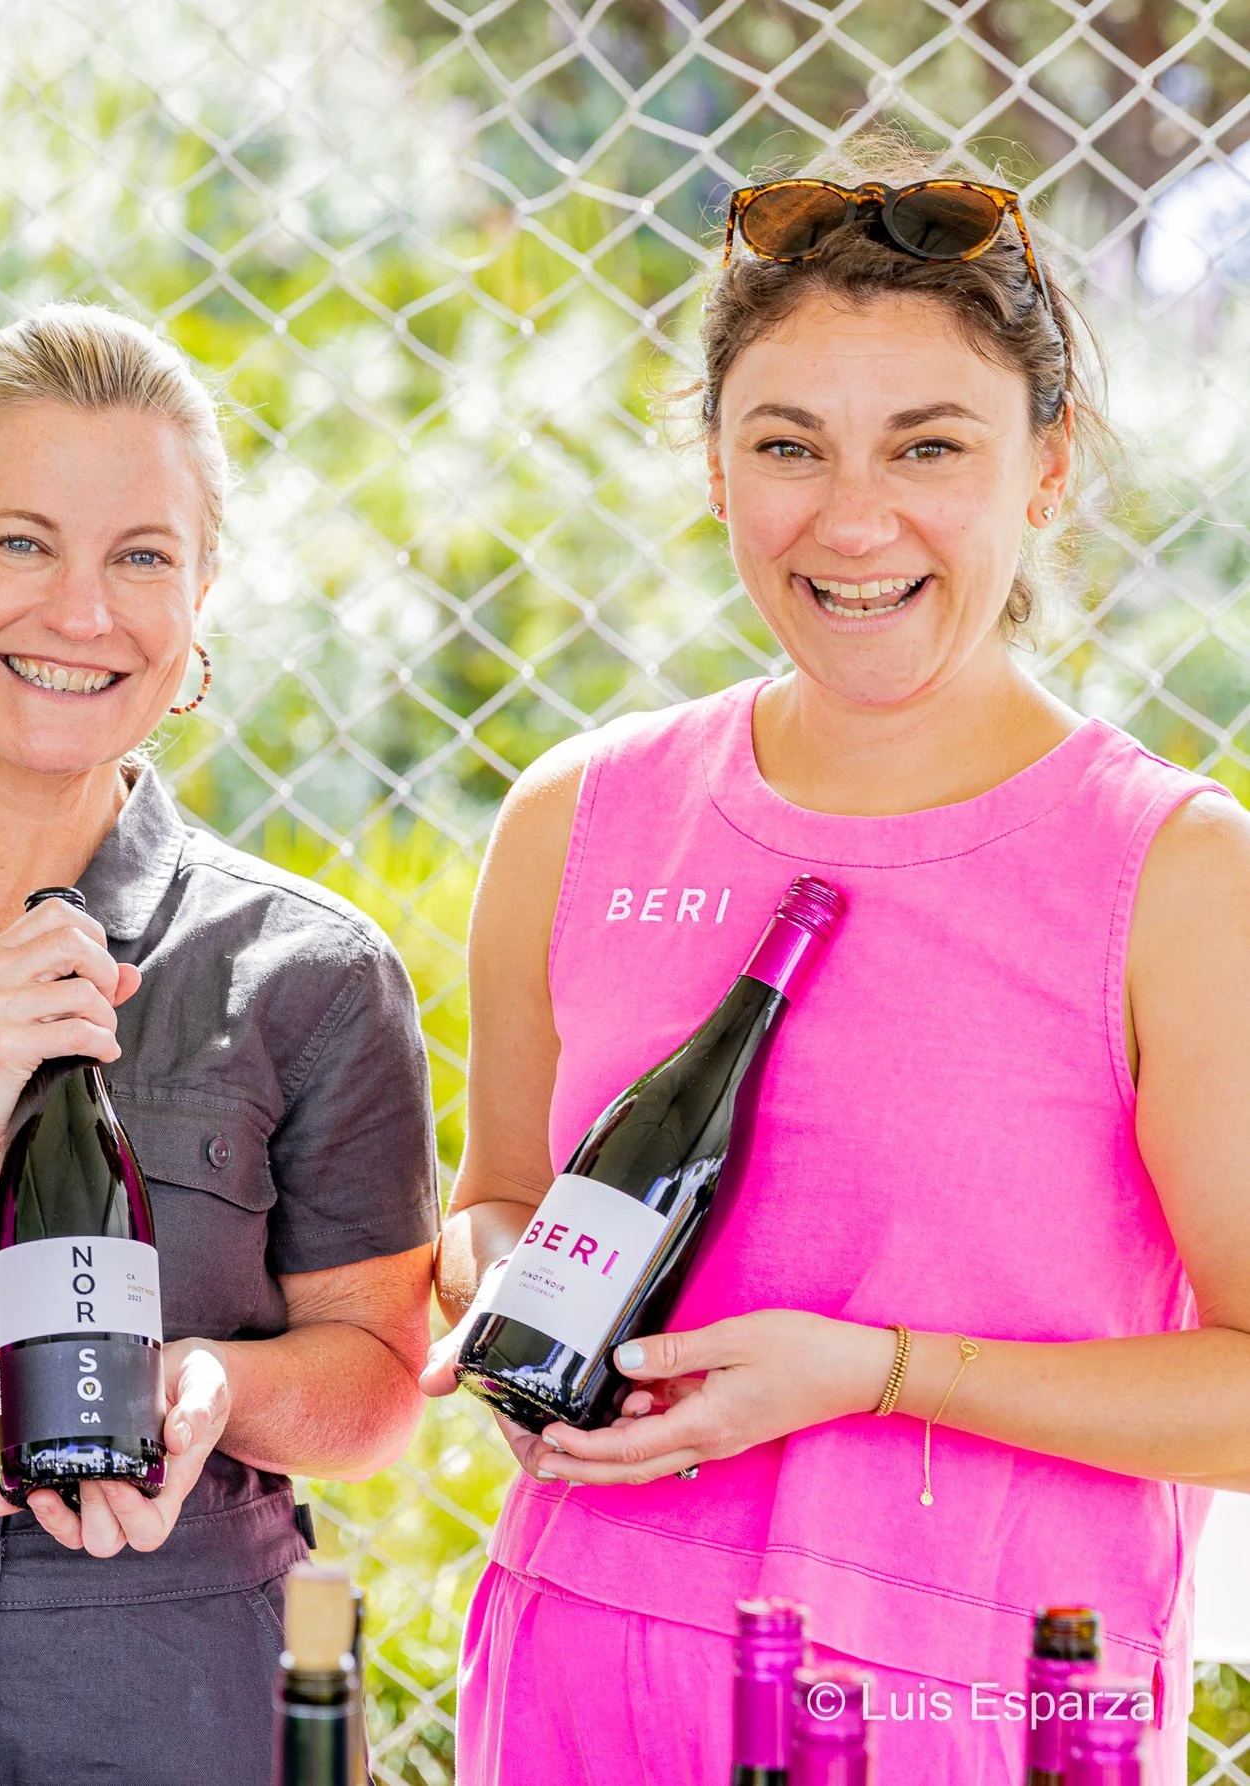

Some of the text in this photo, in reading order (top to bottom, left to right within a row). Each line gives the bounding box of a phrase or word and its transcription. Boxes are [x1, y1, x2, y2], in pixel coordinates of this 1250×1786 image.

[606, 887, 731, 924] BERI
[524, 1220, 620, 1278] BERI
[520, 1270, 566, 1293] PINOT NOIR
[79, 1411, 101, 1424] CA
